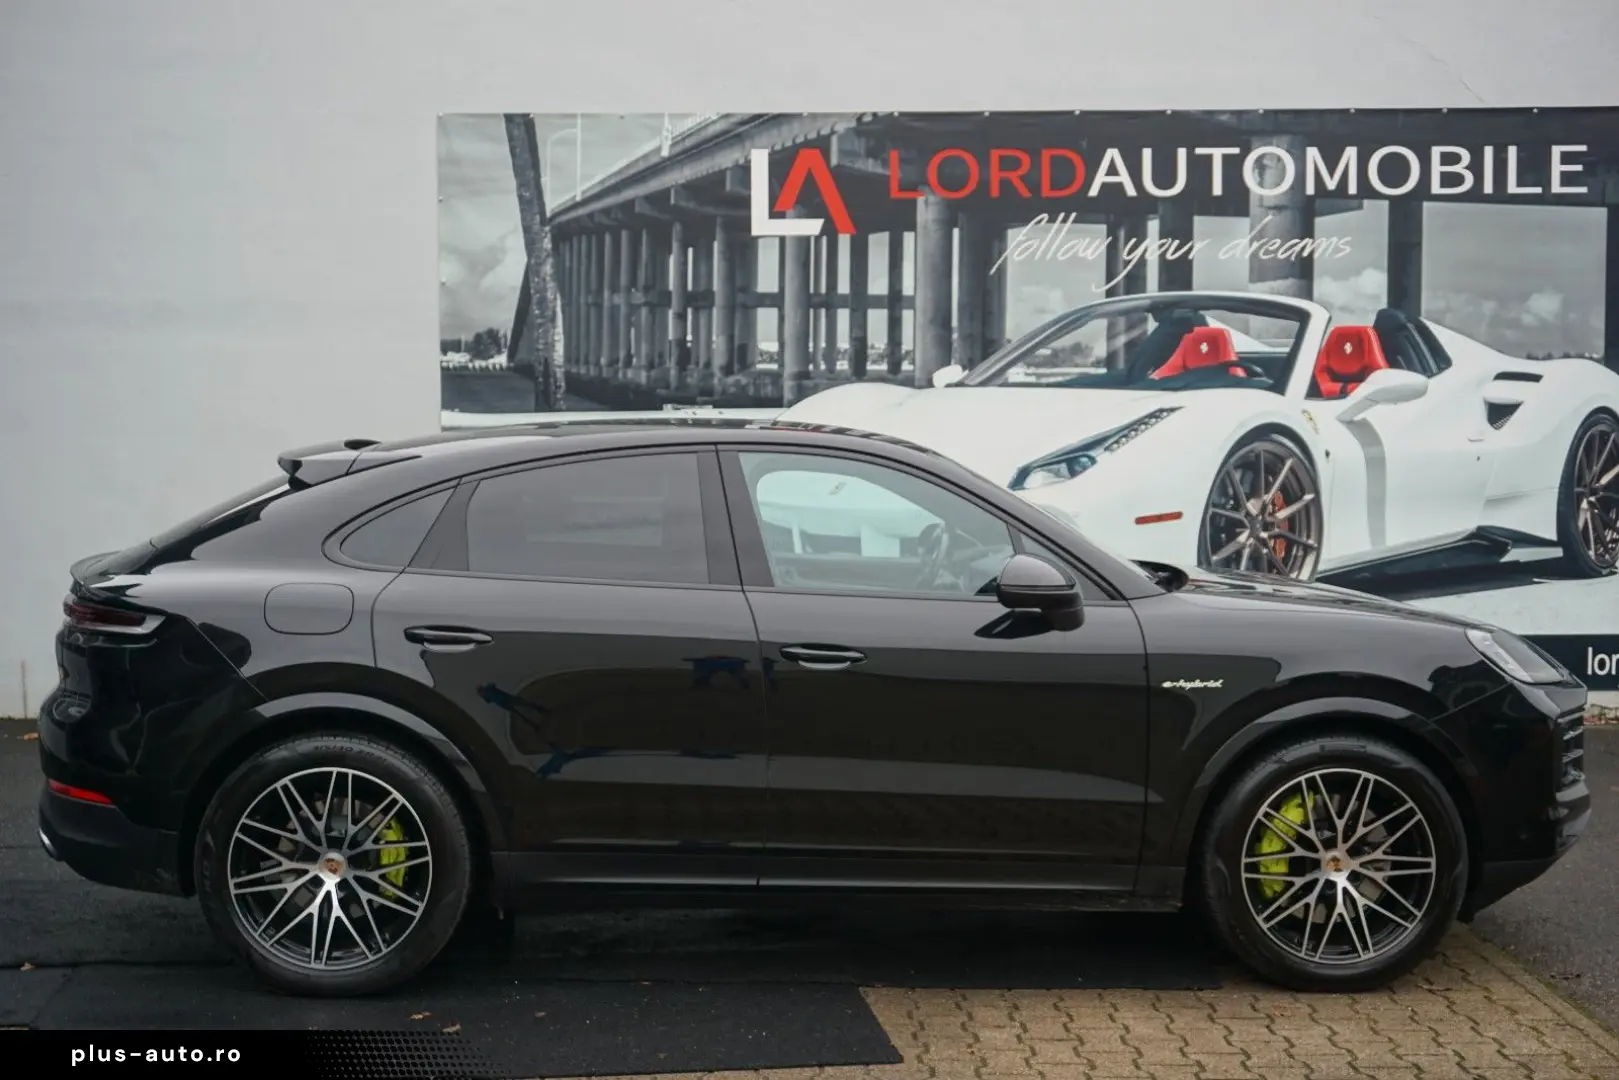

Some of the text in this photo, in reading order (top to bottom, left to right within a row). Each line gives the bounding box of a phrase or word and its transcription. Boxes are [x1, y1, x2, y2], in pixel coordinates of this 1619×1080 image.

[889, 145, 1588, 199] LORDAUTOMOBILE
[989, 211, 1353, 292] follow your dreams
